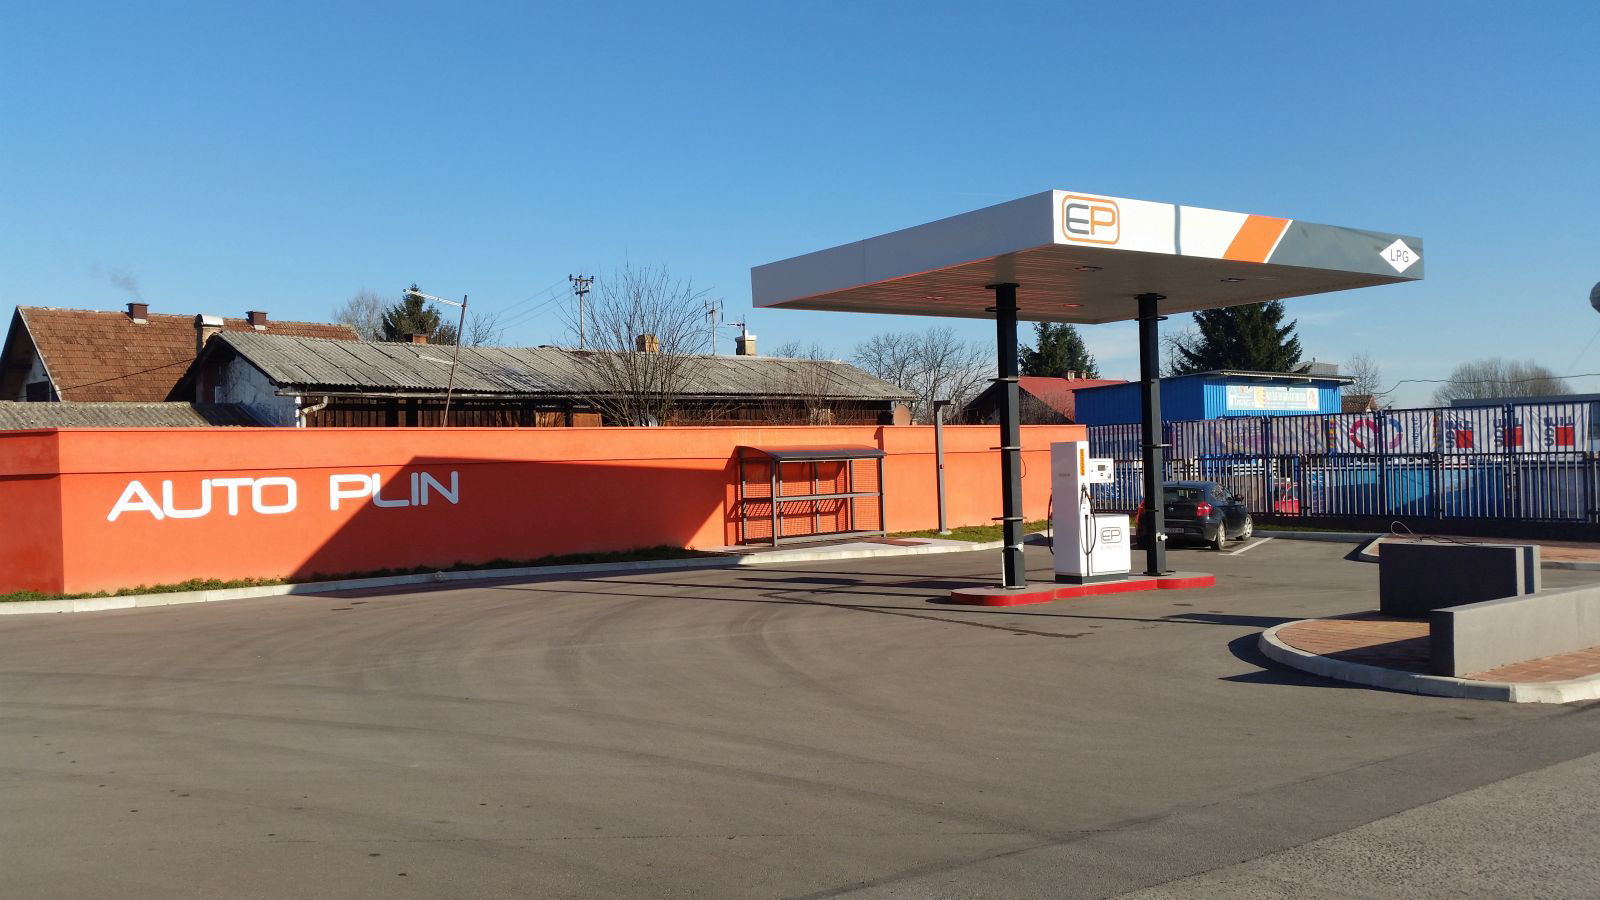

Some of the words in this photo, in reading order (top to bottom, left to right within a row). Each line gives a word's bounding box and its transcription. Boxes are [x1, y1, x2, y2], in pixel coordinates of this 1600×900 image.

[1066, 203, 1115, 235] EP
[1390, 249, 1409, 262] LPG
[107, 476, 298, 521] AUTO
[329, 471, 459, 511] PLIN
[1102, 529, 1120, 541] EP
